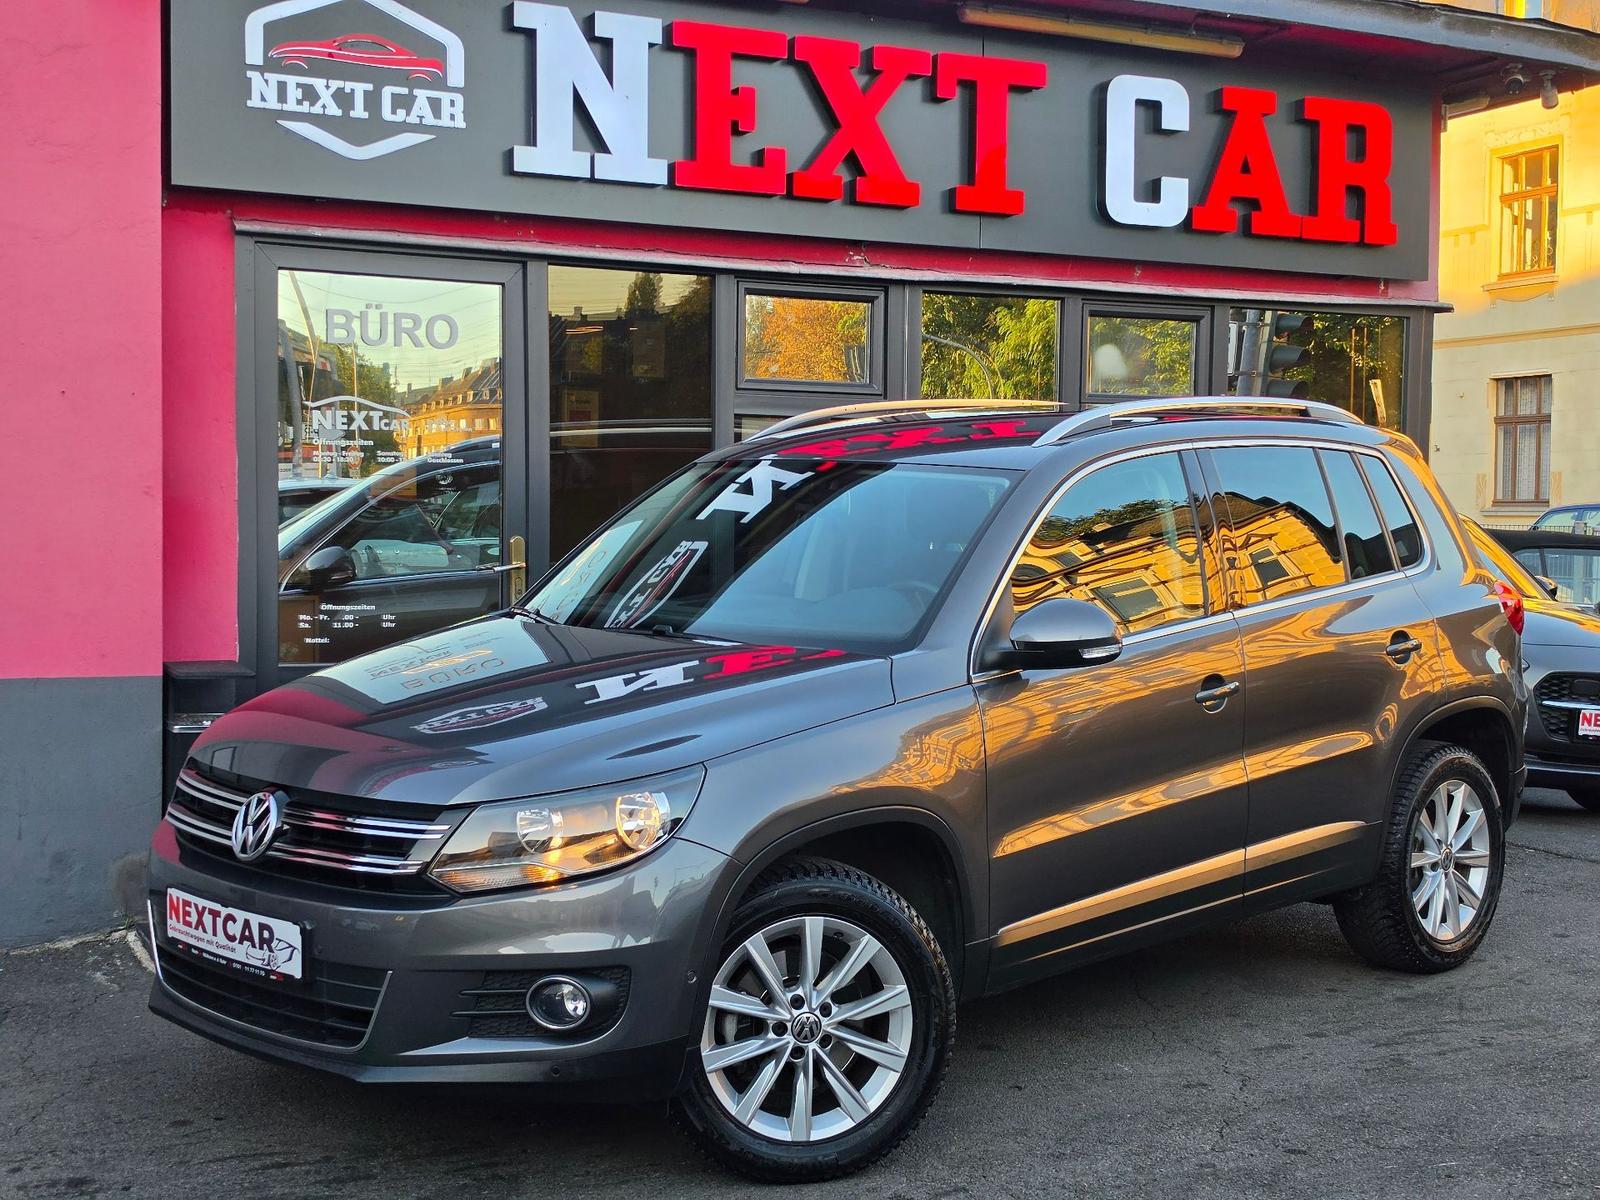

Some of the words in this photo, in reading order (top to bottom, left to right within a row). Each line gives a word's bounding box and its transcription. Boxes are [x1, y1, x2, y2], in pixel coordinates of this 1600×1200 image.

[246, 70, 373, 120] NEXT
[382, 86, 466, 129] CAR
[513, 1, 1047, 216] NEXT
[1104, 74, 1398, 246] CAR
[325, 303, 459, 350] BÜRO
[312, 438, 374, 447] Öffnungszeiten
[321, 602, 375, 611] Öffnungszeiten
[168, 893, 275, 953] NEXTCAR
